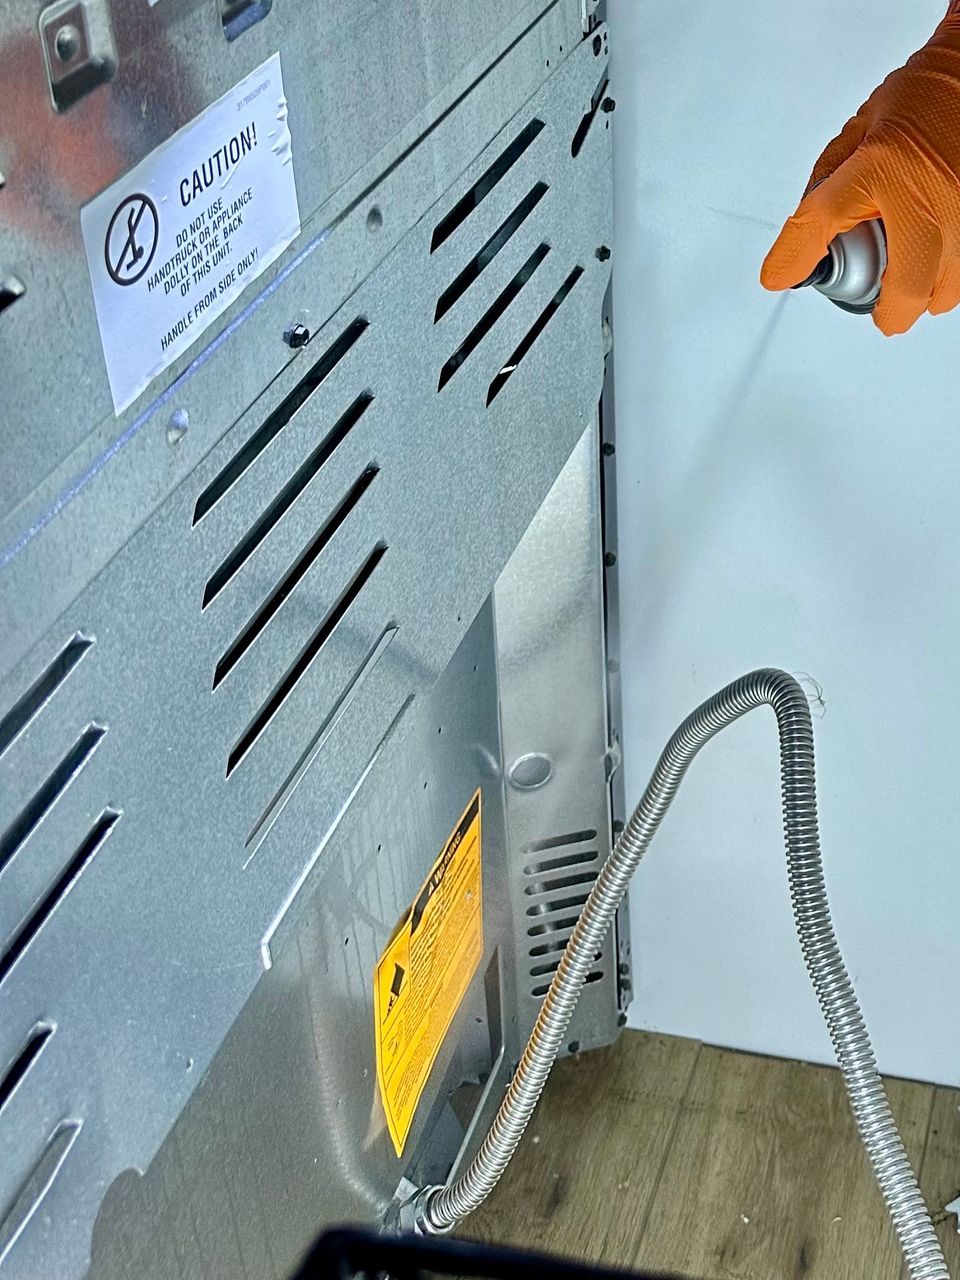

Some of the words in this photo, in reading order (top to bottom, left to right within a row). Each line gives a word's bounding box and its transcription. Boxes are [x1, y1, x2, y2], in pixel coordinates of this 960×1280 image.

[179, 121, 257, 207] CAUTION!
[147, 236, 198, 292] HANDTRUCK
[199, 226, 211, 244] OR
[212, 188, 253, 232] APPLIANCE
[164, 264, 189, 295] DOLLY
[191, 250, 204, 269] ON
[204, 234, 220, 260] THE
[223, 213, 244, 240] BACK
[176, 228, 188, 248] DO
[189, 212, 206, 236] NOT
[207, 197, 223, 220] USE
[160, 310, 193, 351] HANDLE
[194, 287, 218, 318] FROM
[218, 270, 237, 294] SIDE
[237, 247, 259, 275] ONLY!
[180, 278, 192, 297] OF
[192, 261, 211, 285] THIS
[212, 241, 233, 267] UNIT.
